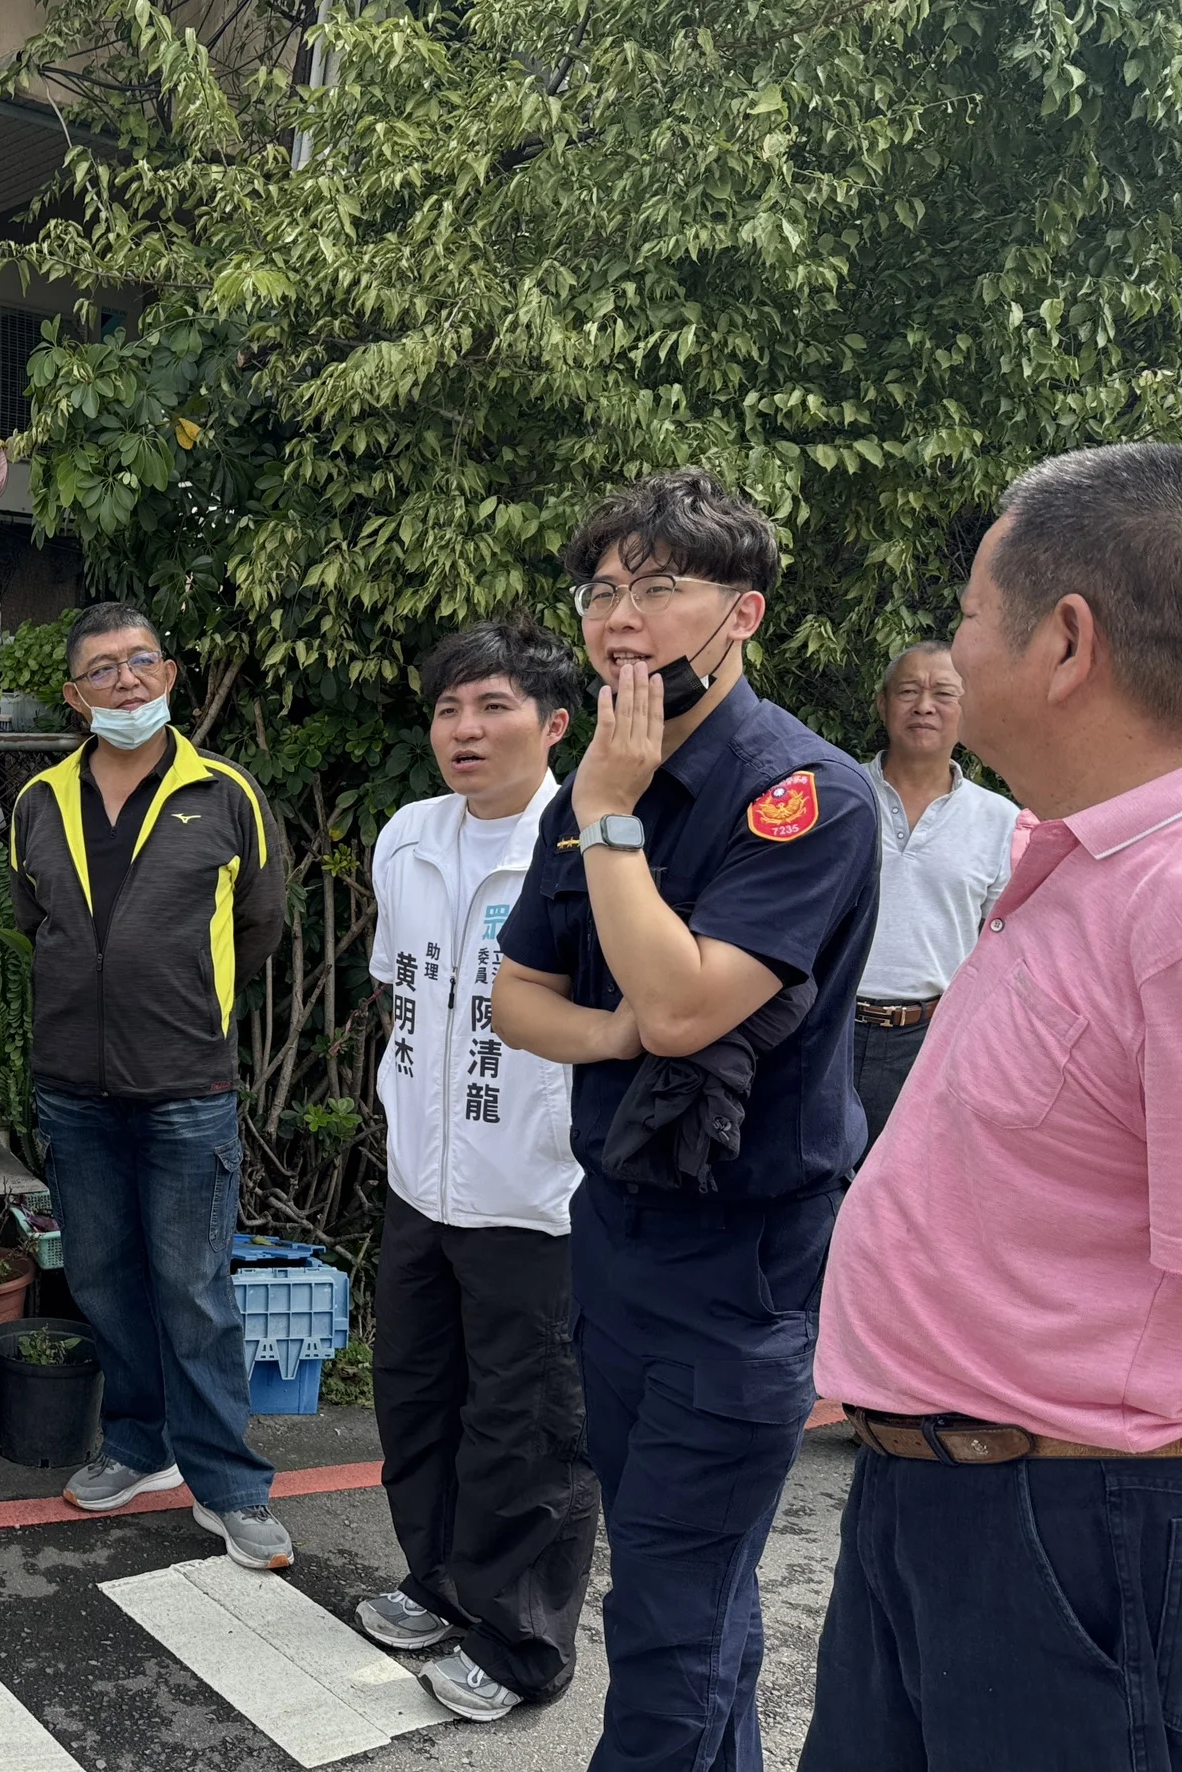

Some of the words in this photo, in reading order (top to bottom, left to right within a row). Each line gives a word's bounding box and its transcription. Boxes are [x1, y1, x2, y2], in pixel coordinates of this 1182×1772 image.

[772, 824, 799, 835] 7235
[424, 942, 440, 980] 助理
[475, 947, 490, 984] 委員
[465, 995, 502, 1123] 陳清龍
